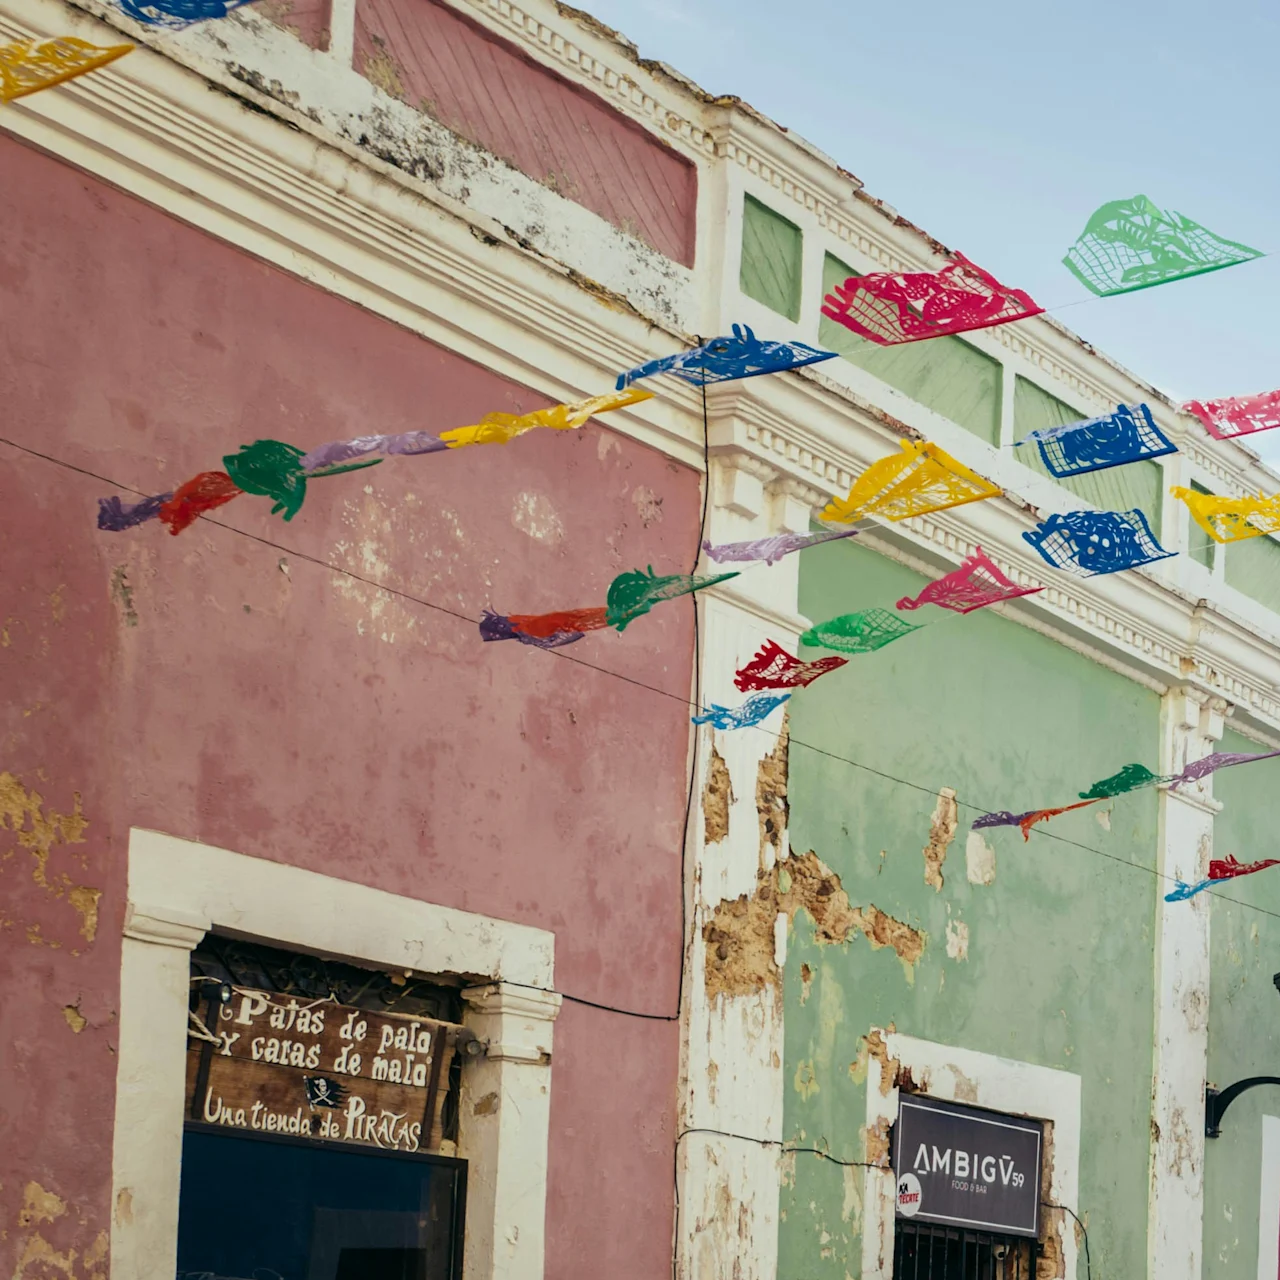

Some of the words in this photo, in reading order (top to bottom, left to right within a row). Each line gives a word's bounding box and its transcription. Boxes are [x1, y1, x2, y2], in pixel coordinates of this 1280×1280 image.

[340, 1011, 368, 1042] de
[251, 1035, 321, 1069] caras
[333, 1043, 362, 1076] de
[371, 1055, 429, 1088] malo
[203, 1086, 247, 1127] Una
[251, 1100, 313, 1136] tienda
[319, 1112, 341, 1139] de
[951, 1180, 969, 1192] FOOD
[975, 1184, 988, 1195] BAR
